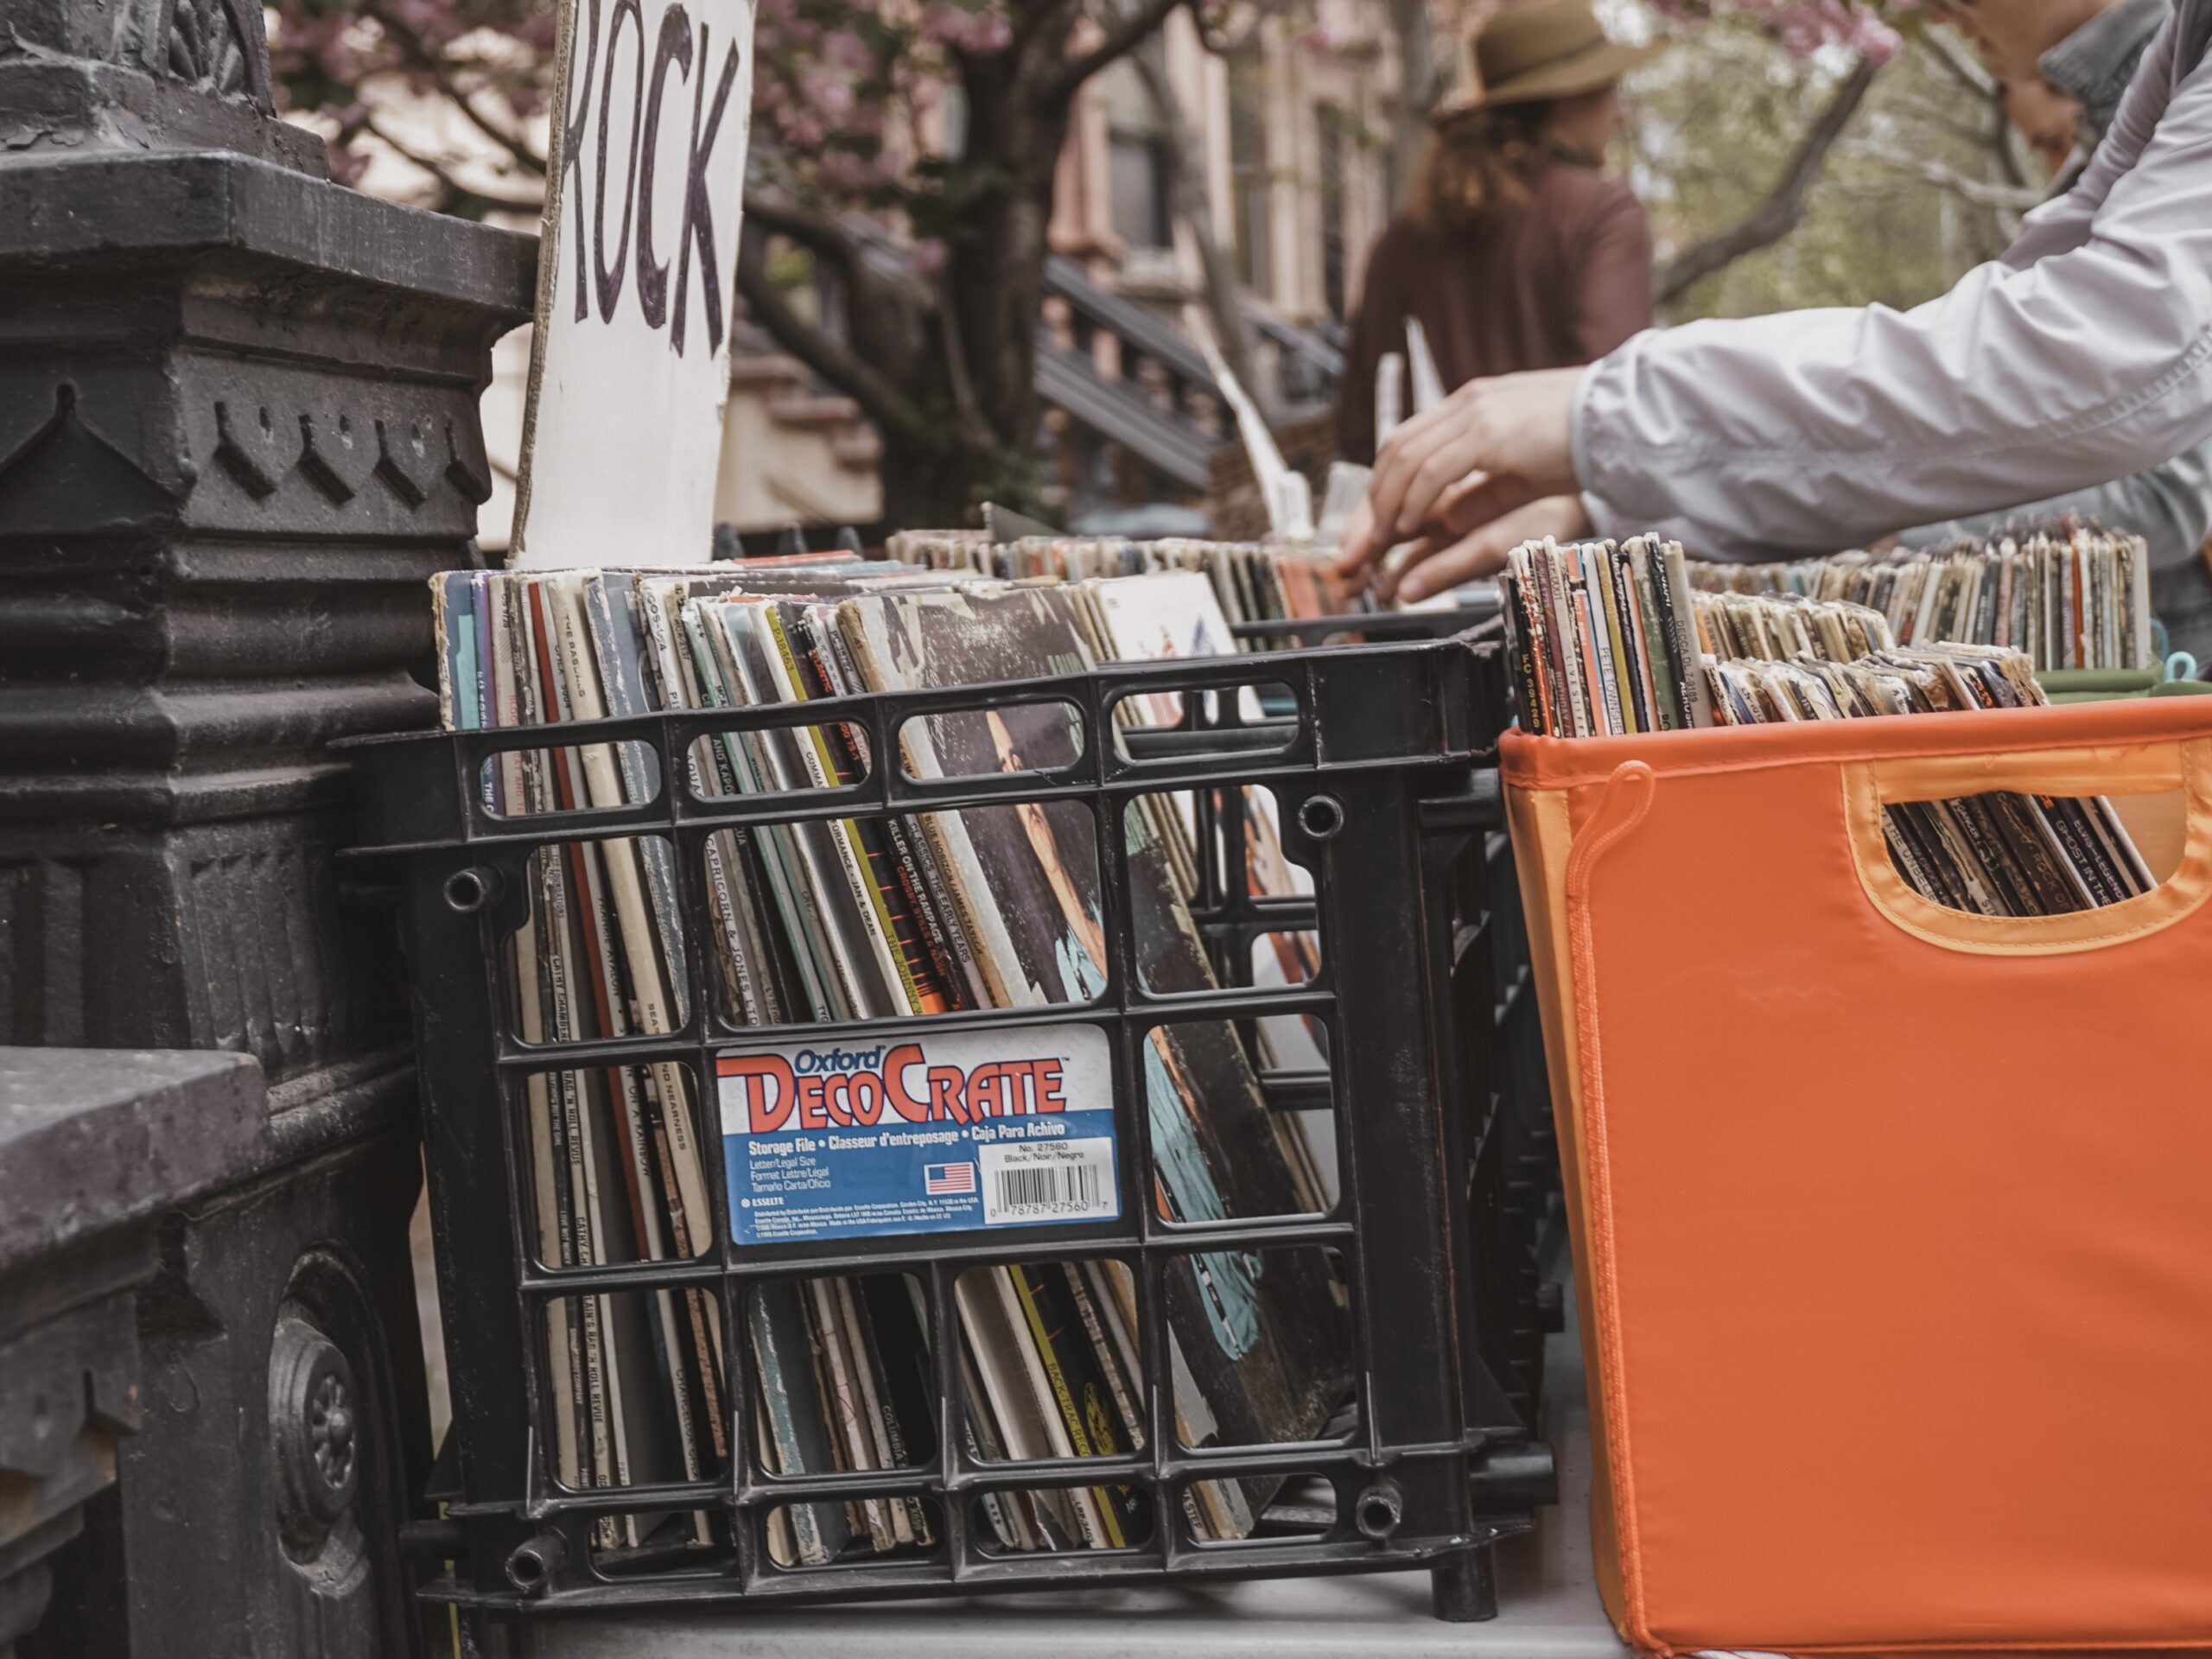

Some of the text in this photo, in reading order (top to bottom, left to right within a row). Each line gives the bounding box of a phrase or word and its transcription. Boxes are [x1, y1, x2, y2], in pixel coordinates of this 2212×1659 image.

[558, 0, 741, 359] ROCK
[1676, 620, 1690, 656] DECCA
[1684, 657, 1693, 671] DL
[1566, 656, 1578, 686] LIVE
[1600, 647, 1625, 734] PETE TOWNSHE
[712, 739, 725, 761] AND
[923, 814, 937, 838] BLUE
[2031, 853, 2057, 890] ROCK
[2056, 819, 2113, 906] GHOST IN THE
[888, 819, 944, 944] KILLER ON THE RAMPAGE
[705, 836, 734, 922] CAPRICORN
[731, 945, 750, 992] JONES
[849, 880, 861, 899] JAN
[862, 912, 876, 937] DEAN
[929, 874, 945, 895] THE
[937, 895, 958, 928] EARLY
[949, 928, 971, 963] YEARS
[885, 933, 899, 959] THE
[553, 957, 564, 988] CATHY
[794, 1046, 883, 1074] Oxford
[563, 1072, 575, 1091] RAG
[552, 1118, 561, 1131] THE
[568, 1108, 578, 1130] ROLL
[666, 1084, 688, 1152] NEARNESS
[570, 1135, 582, 1166] REVUE
[748, 1121, 1066, 1156] Storage File Classeur d'entreposage Caja Para Achivo
[1018, 1144, 1034, 1153] No.
[749, 1155, 817, 1170] Letter/Legal Size
[1004, 1151, 1084, 1163] Black/Noir/Negro
[750, 1170, 780, 1181] Format
[752, 1196, 785, 1207] ESSELTE
[989, 1201, 1109, 1218] 0 78787 27560 7
[558, 1211, 572, 1265] LOVE NOT MONEY
[575, 1216, 589, 1248] CATHY
[589, 1366, 601, 1390] ROLL
[591, 1393, 604, 1424] REVUE
[881, 1405, 904, 1461] COLUMBIA
